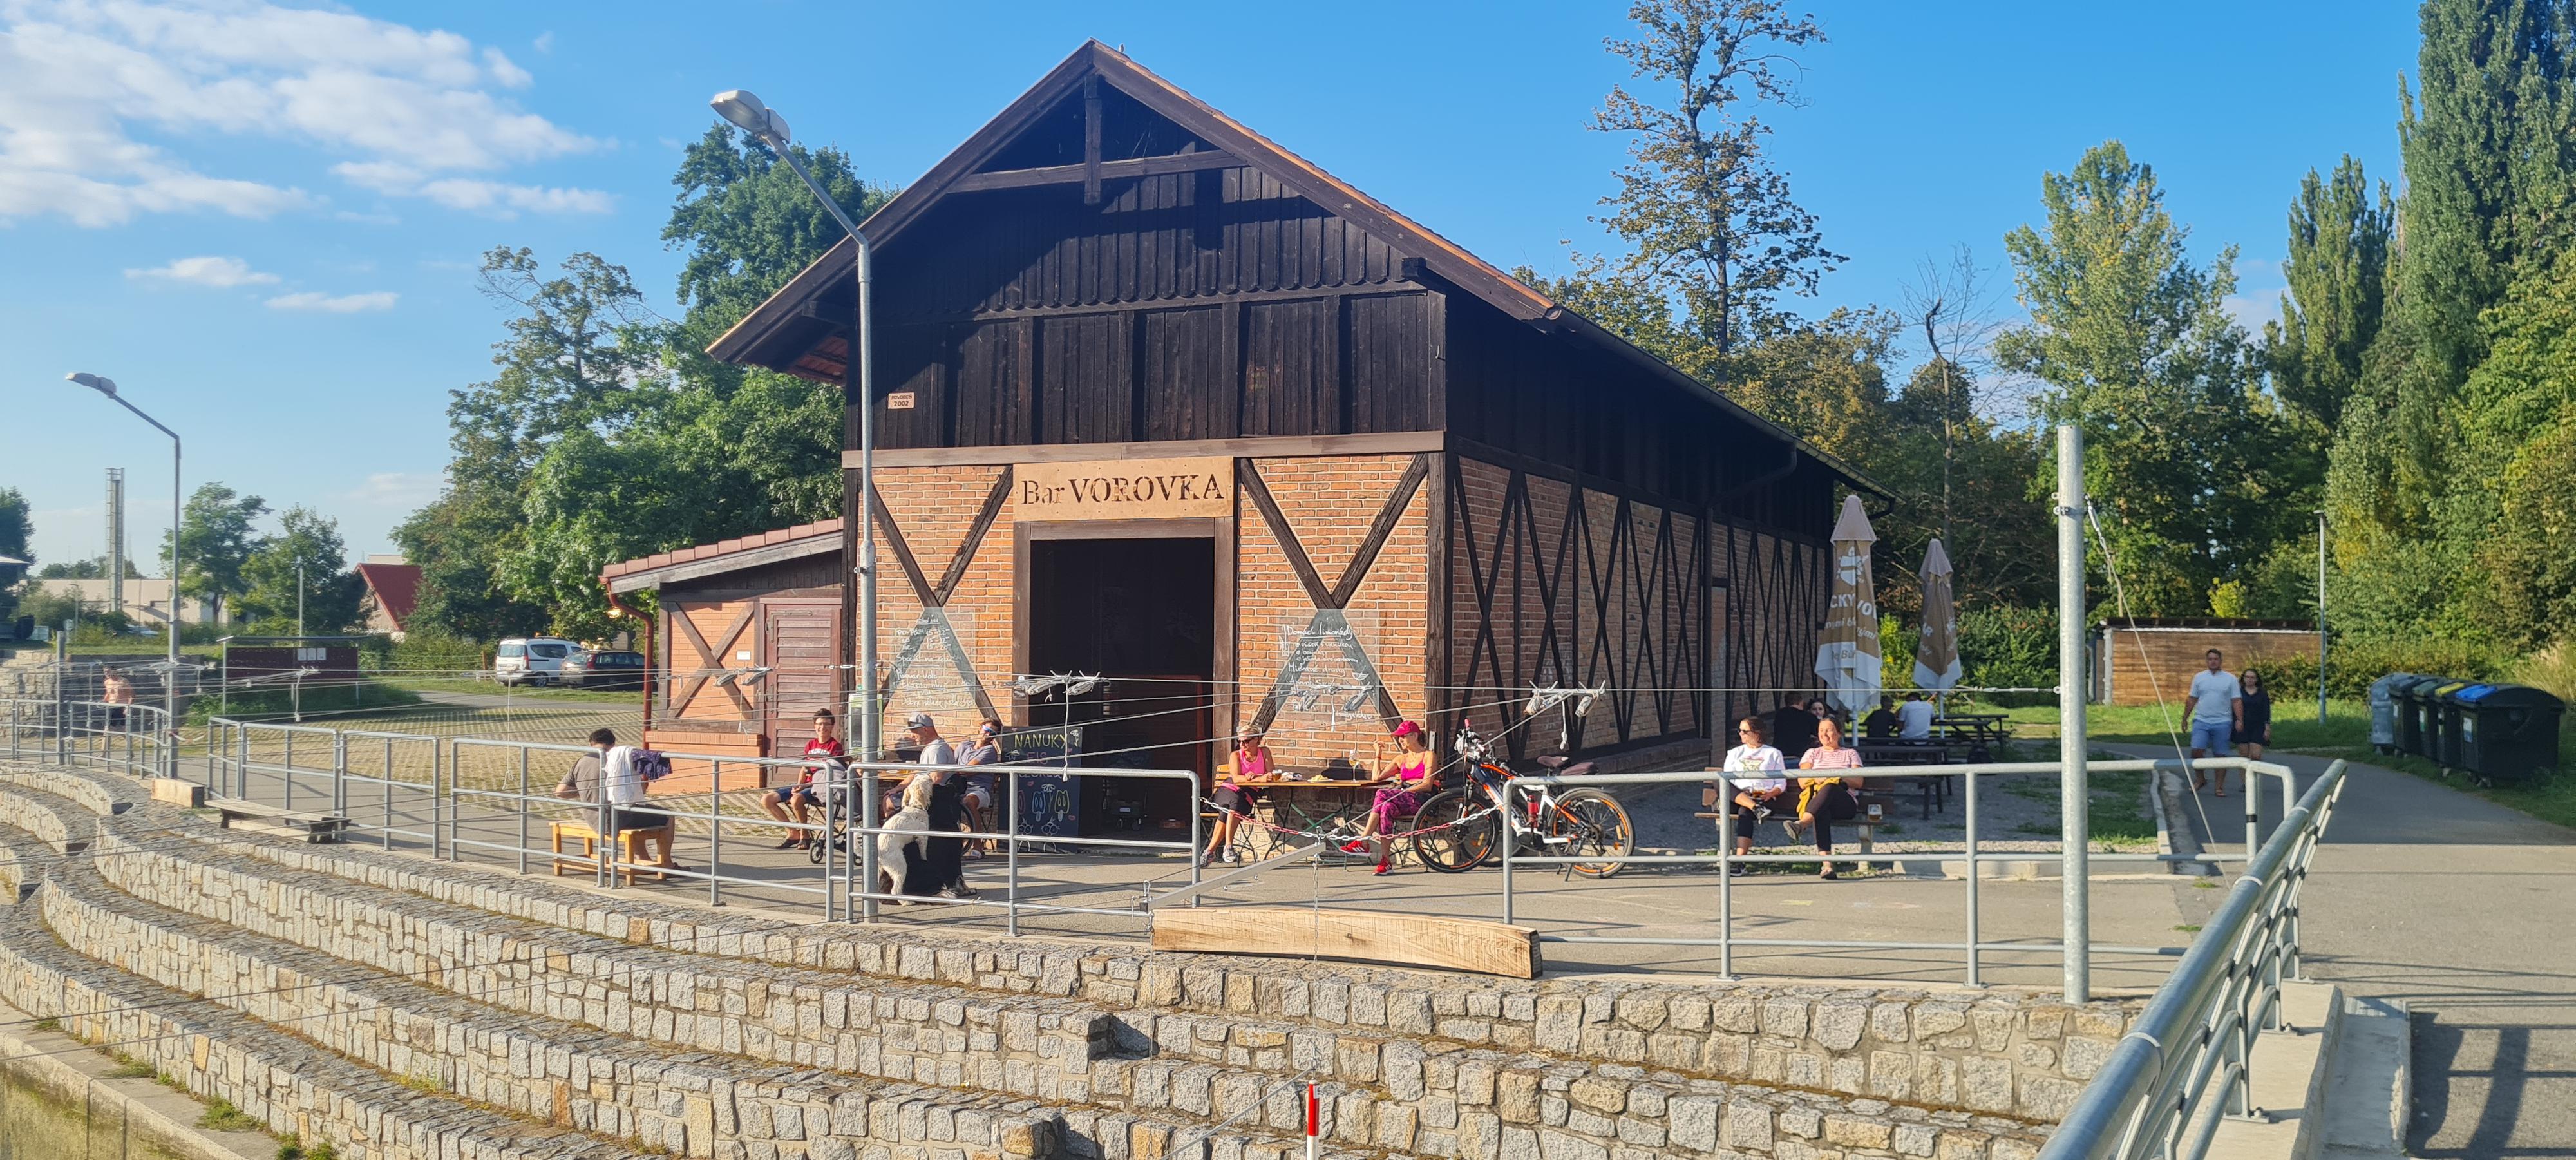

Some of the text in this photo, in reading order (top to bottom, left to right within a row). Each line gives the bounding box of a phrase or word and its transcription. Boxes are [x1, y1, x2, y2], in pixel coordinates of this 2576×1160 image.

[1021, 473, 1224, 505] Bar VOROVKA
[922, 670, 938, 679] Volt
[1014, 734, 1067, 749] NANUKY
